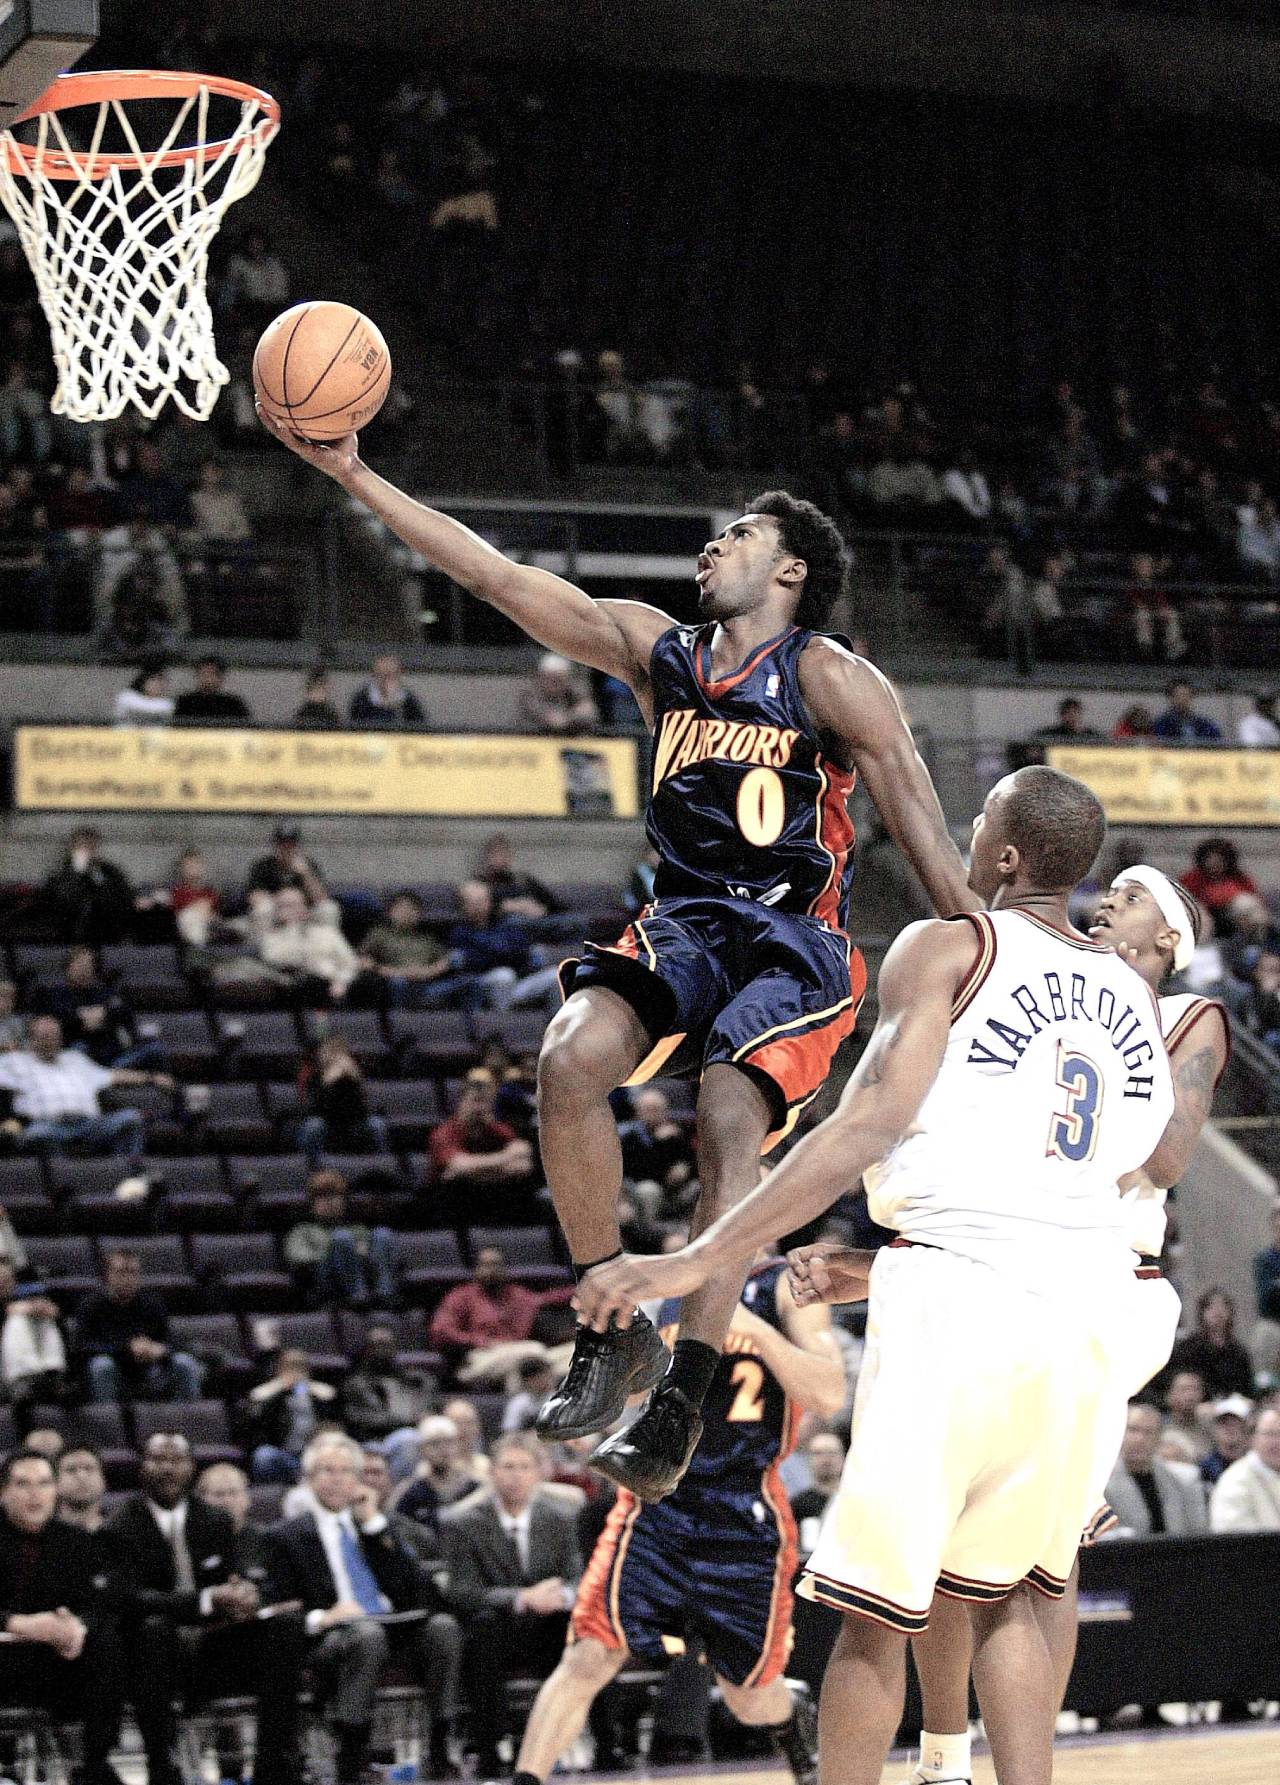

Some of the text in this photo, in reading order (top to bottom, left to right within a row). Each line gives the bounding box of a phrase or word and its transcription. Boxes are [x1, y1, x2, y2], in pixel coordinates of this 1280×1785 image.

[361, 347, 379, 371] NBA
[736, 766, 785, 847] 0
[967, 972, 1154, 1102] YARBROUGH
[1046, 1039, 1105, 1161] 3
[726, 1359, 765, 1423] 2
